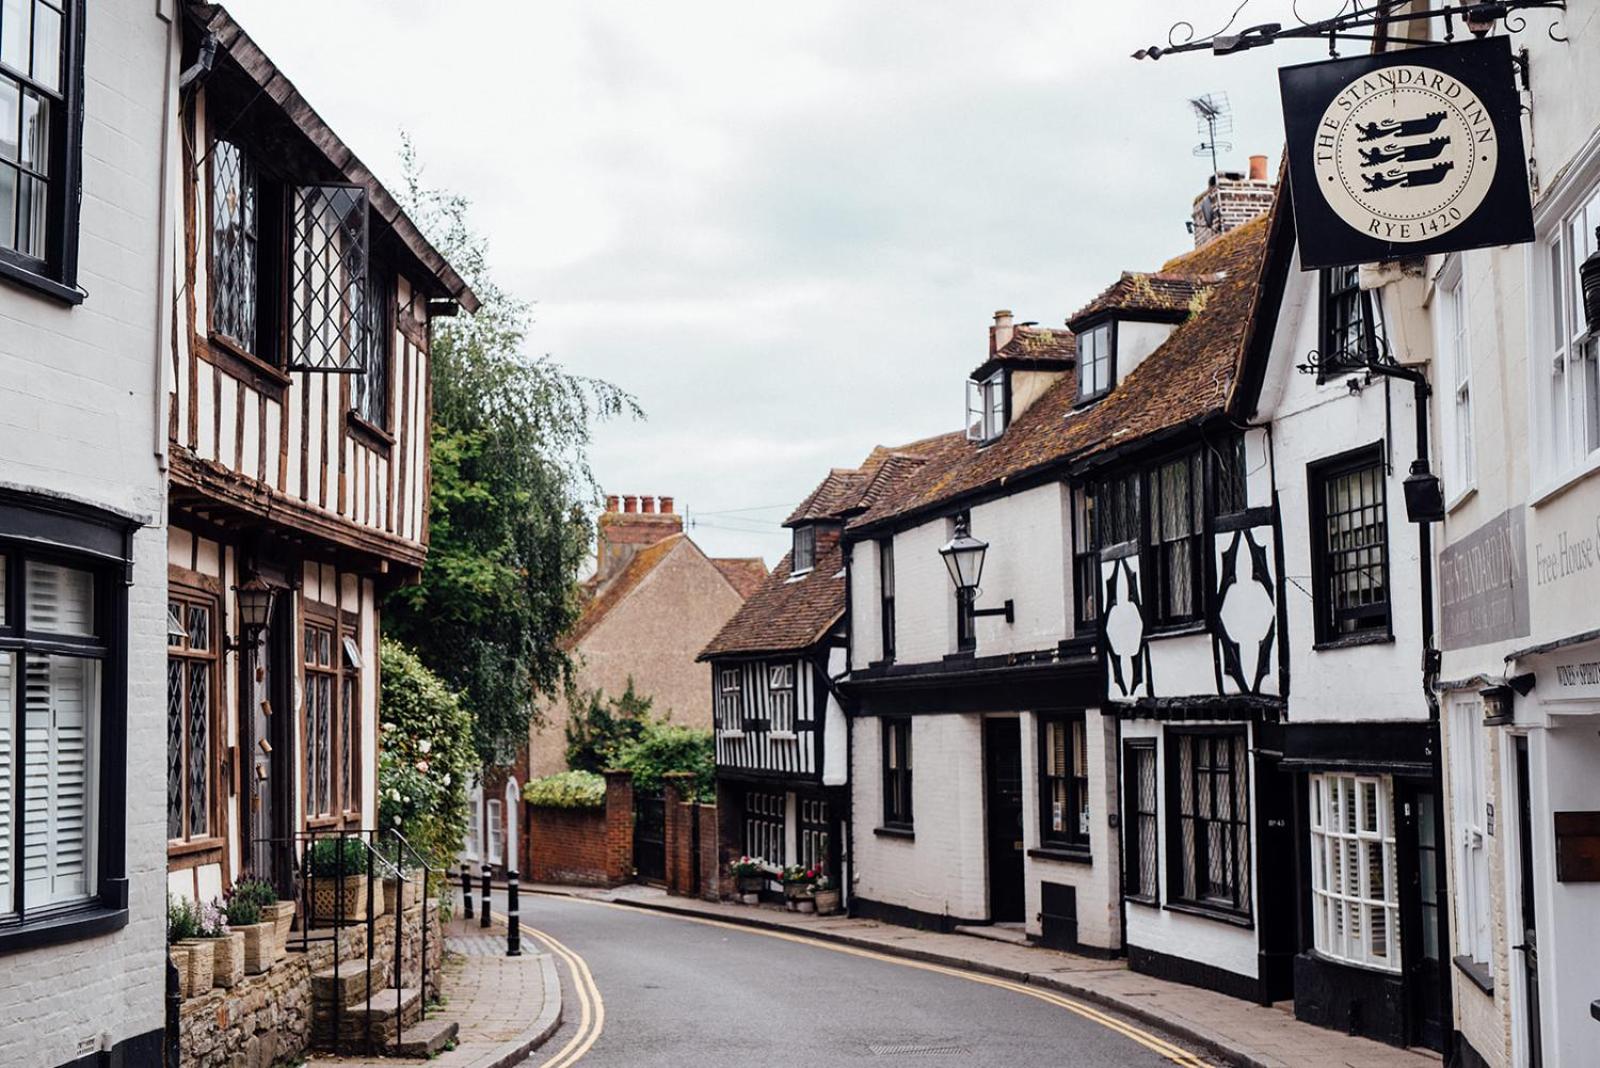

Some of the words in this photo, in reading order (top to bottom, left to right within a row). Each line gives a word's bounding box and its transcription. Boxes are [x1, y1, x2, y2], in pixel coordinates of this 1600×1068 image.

[1317, 118, 1340, 165] THE
[1338, 69, 1462, 111] STANDARD
[1463, 99, 1493, 144] INN
[1368, 218, 1410, 238] RYE
[1419, 206, 1462, 236] 1420
[1455, 534, 1499, 602] STANDARD
[1536, 543, 1557, 585] Free
[1558, 531, 1593, 577] House
